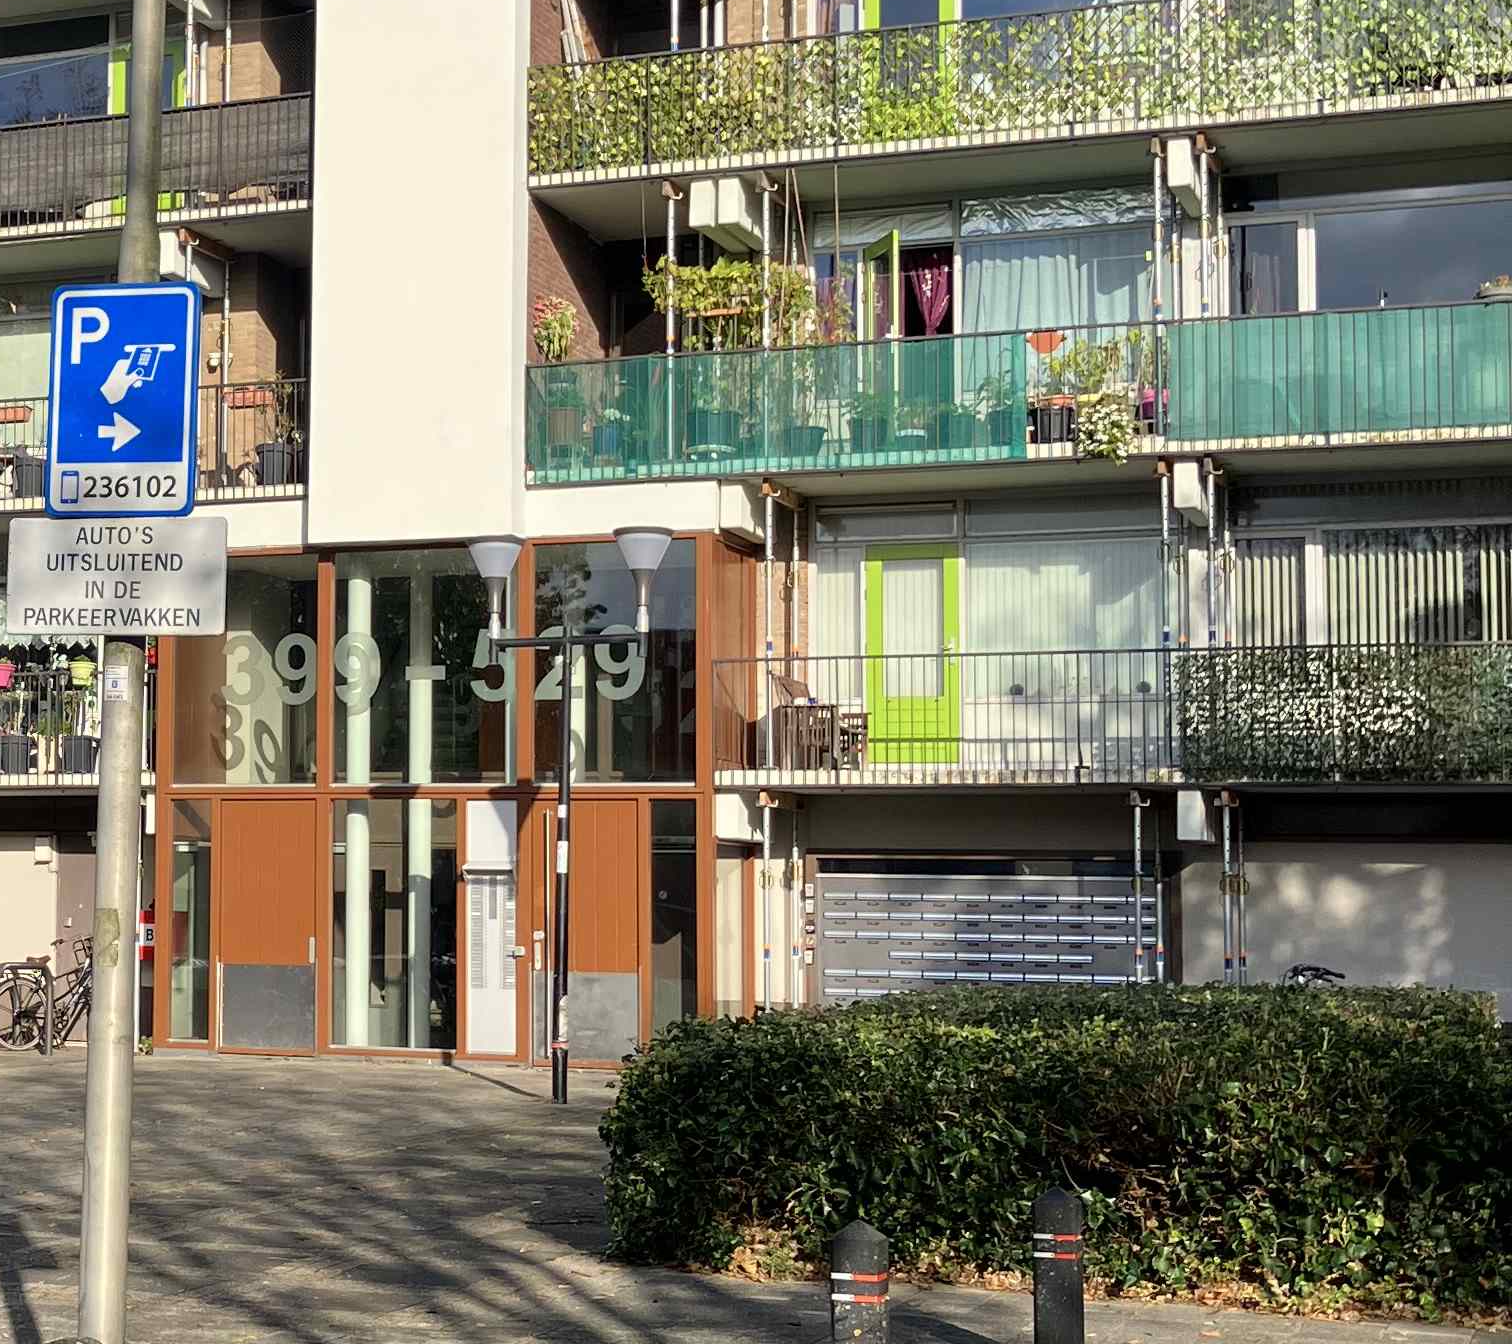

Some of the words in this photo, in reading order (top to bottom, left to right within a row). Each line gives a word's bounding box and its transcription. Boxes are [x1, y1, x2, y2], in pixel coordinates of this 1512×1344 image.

[70, 306, 110, 365] P
[82, 475, 177, 499] 236102
[75, 526, 154, 545] AUTO'S
[46, 553, 184, 572] UITSLUITEND
[84, 581, 105, 599] IN
[114, 581, 142, 599] DE
[23, 607, 201, 627] PARKEERVAKKEN
